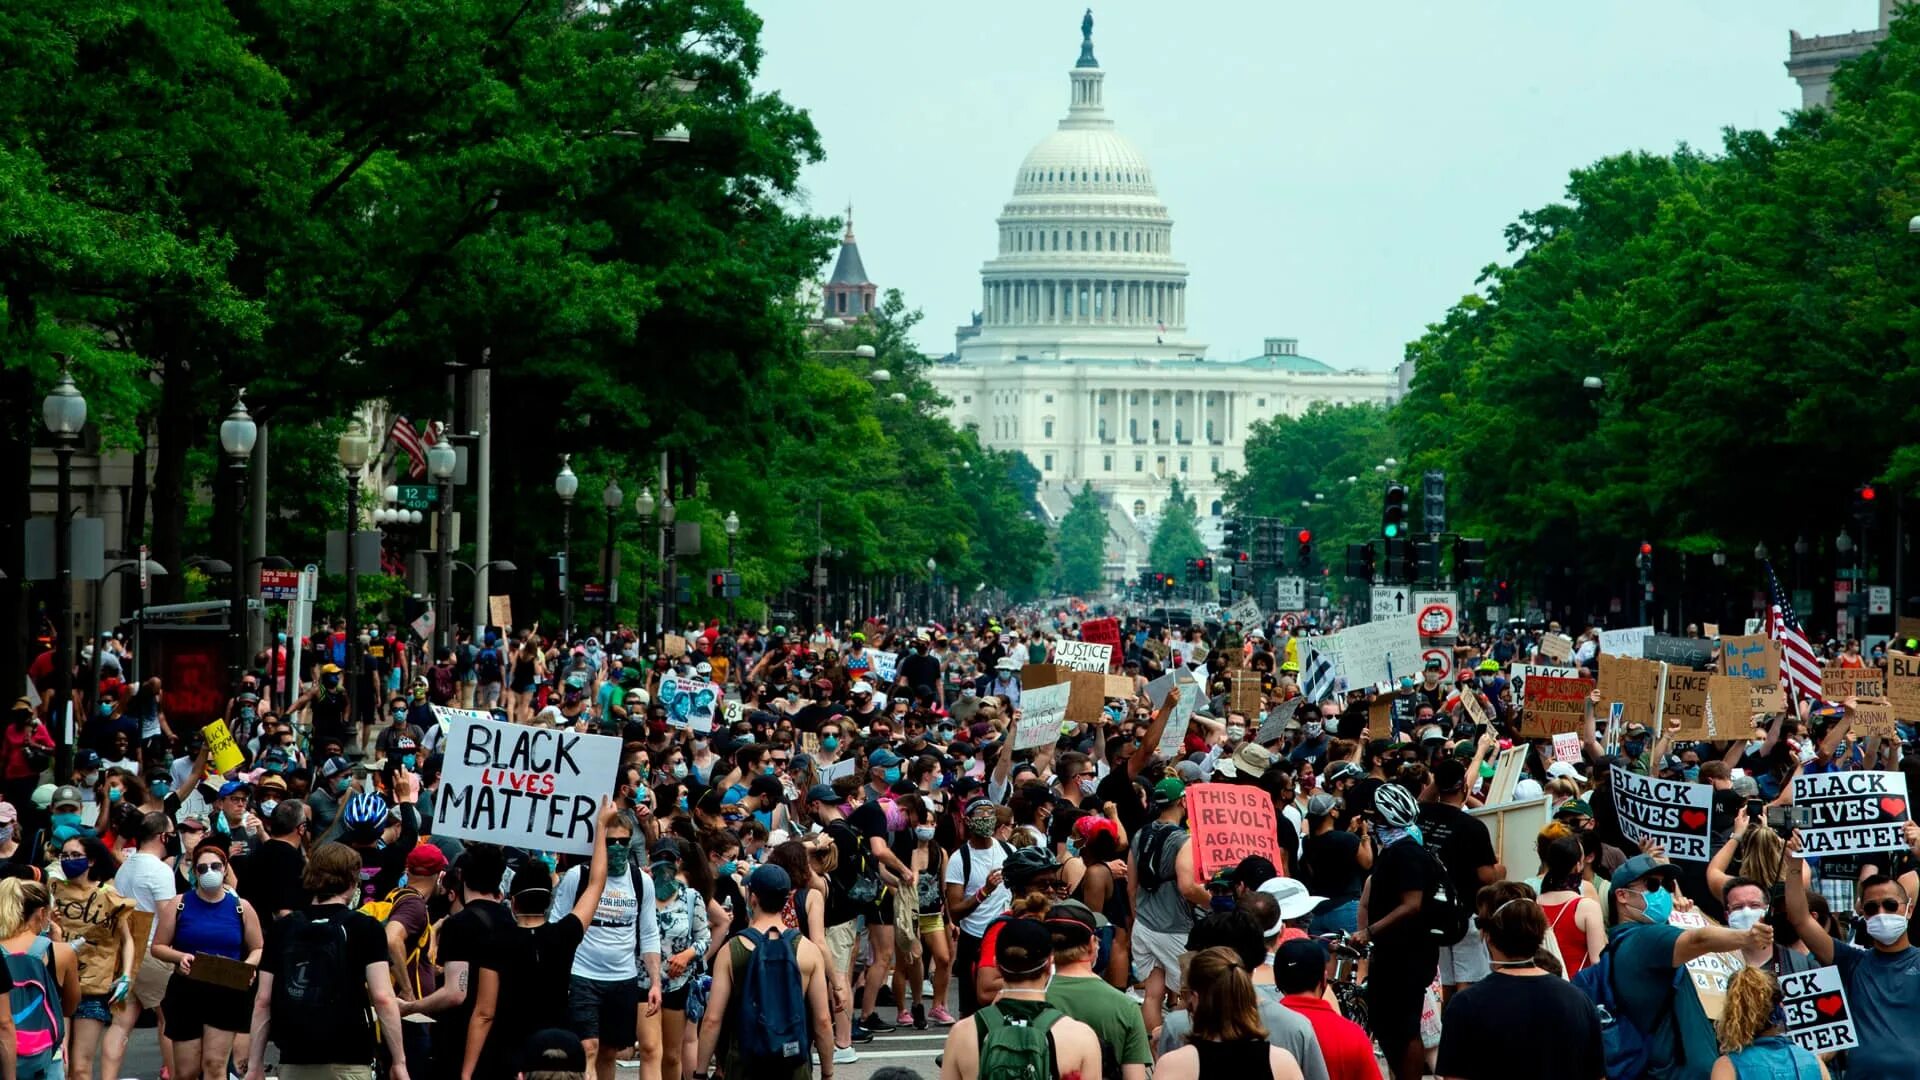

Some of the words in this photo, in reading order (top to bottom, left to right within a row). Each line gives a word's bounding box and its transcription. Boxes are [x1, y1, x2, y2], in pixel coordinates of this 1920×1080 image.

[405, 488, 418, 499] 12
[1058, 642, 1111, 660] JUSTICE
[1656, 647, 1703, 660] LIVE
[1525, 666, 1569, 678] BLACK
[1824, 670, 1845, 680] STOP
[1894, 658, 1920, 677] BL
[1653, 674, 1706, 690] SLENCE
[1673, 693, 1680, 701] IS
[1650, 703, 1701, 717] VOLENCE
[464, 724, 581, 776] BLACK
[1556, 744, 1579, 756] MATTER
[482, 768, 555, 795] LIVES
[1612, 768, 1692, 805] BLACK
[1794, 774, 1888, 799] BLACK
[1199, 790, 1237, 805] THIS
[1241, 794, 1257, 807] IS
[1262, 798, 1271, 811] A
[1615, 792, 1680, 829] LIVES
[1810, 798, 1880, 824] IVES
[438, 783, 597, 844] MATTER
[1202, 808, 1272, 830] REVOLT
[1206, 832, 1276, 850] AGAINST
[1800, 825, 1907, 853] MATTER
[1781, 972, 1822, 998] CK
[1783, 1001, 1818, 1026] ES
[1795, 1024, 1854, 1051] TER
